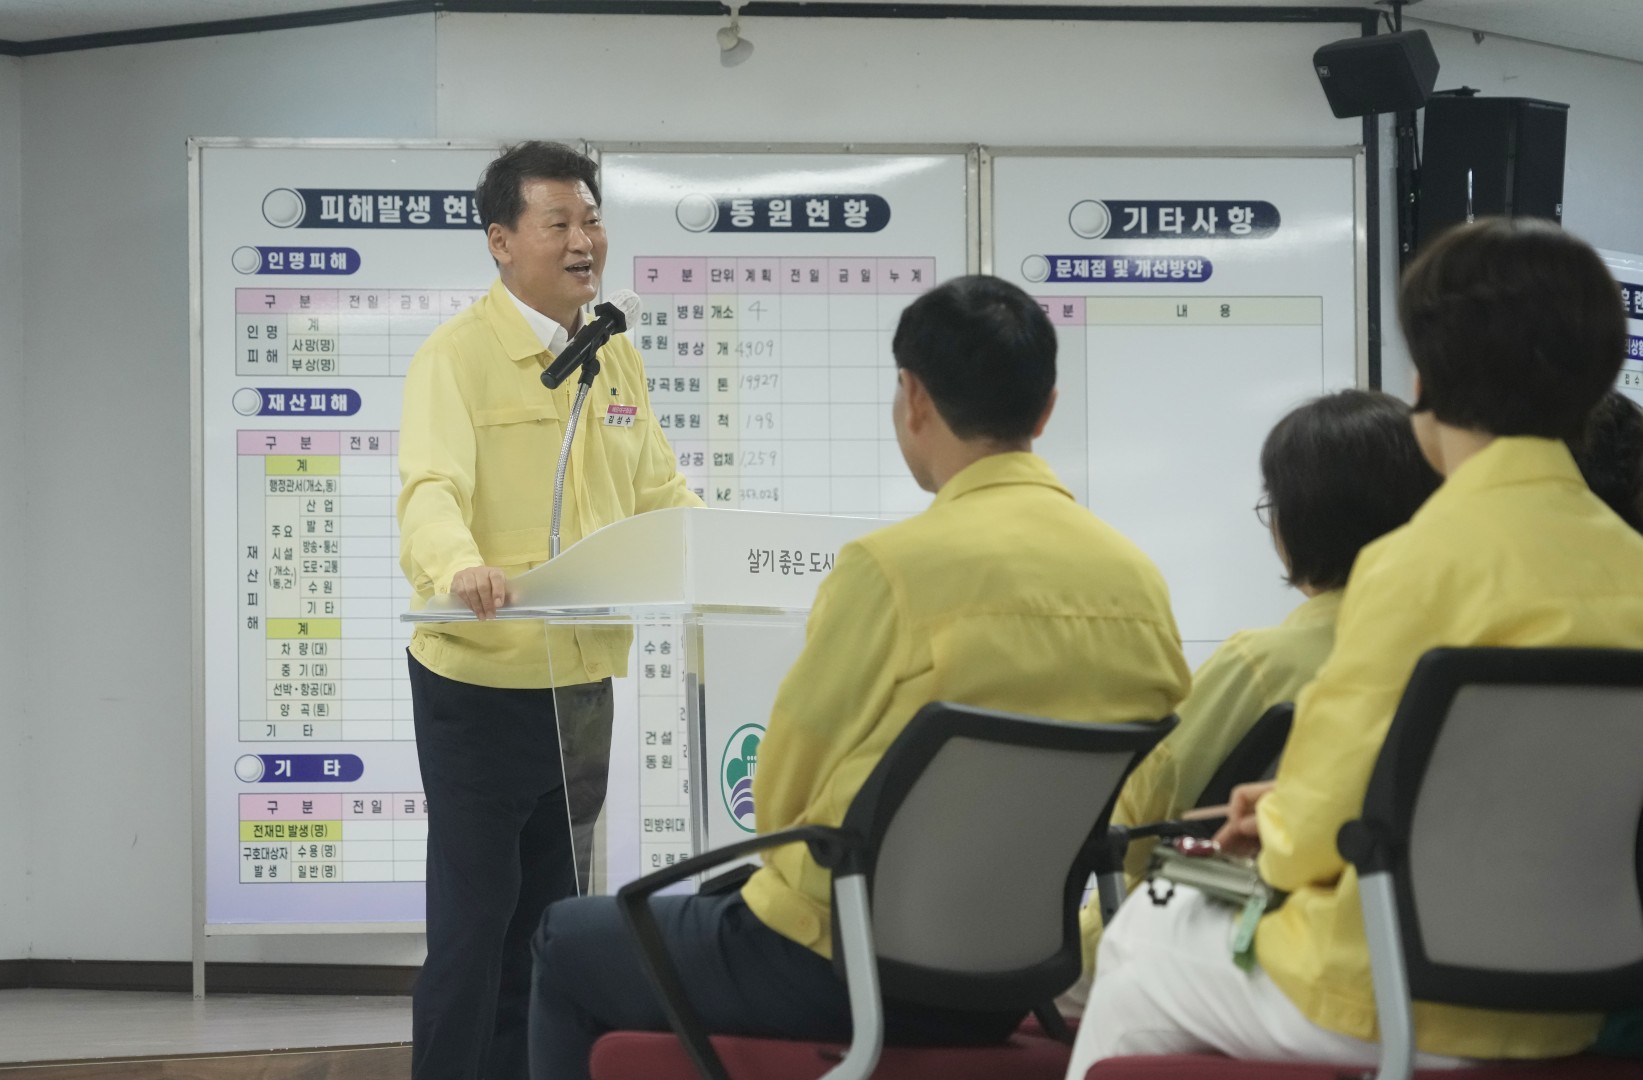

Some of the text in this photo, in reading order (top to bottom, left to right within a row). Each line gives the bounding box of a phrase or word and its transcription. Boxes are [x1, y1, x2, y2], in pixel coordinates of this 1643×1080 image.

[320, 194, 430, 223] 피해발생
[730, 198, 869, 228] 동원현황
[1123, 206, 1255, 235] 기타사항
[268, 252, 347, 270] 인명피해
[1056, 258, 1204, 279] 문제점 및 개선방안
[711, 268, 734, 283] 단위
[745, 268, 771, 283] 계획
[641, 304, 734, 326] 의료 병원 개소
[747, 300, 769, 322] 4
[307, 318, 319, 332] 계
[292, 339, 335, 353] 사망(명)
[677, 341, 729, 356] 병상 개
[291, 359, 336, 373] 부상(명)
[717, 378, 729, 393] 톤
[268, 393, 348, 412] 재산피해
[608, 415, 631, 425] 김성수
[717, 414, 730, 428] 척
[746, 412, 775, 429] 198
[296, 459, 308, 472] 계
[680, 452, 735, 467] 상공 업체
[271, 525, 293, 539] 주요
[272, 547, 293, 561] 시설
[747, 548, 835, 576] 살기 좋은 도시
[297, 622, 309, 636] 계
[644, 641, 671, 655] 수송
[253, 824, 285, 838] 전재민
[242, 846, 288, 861] 구호대상자
